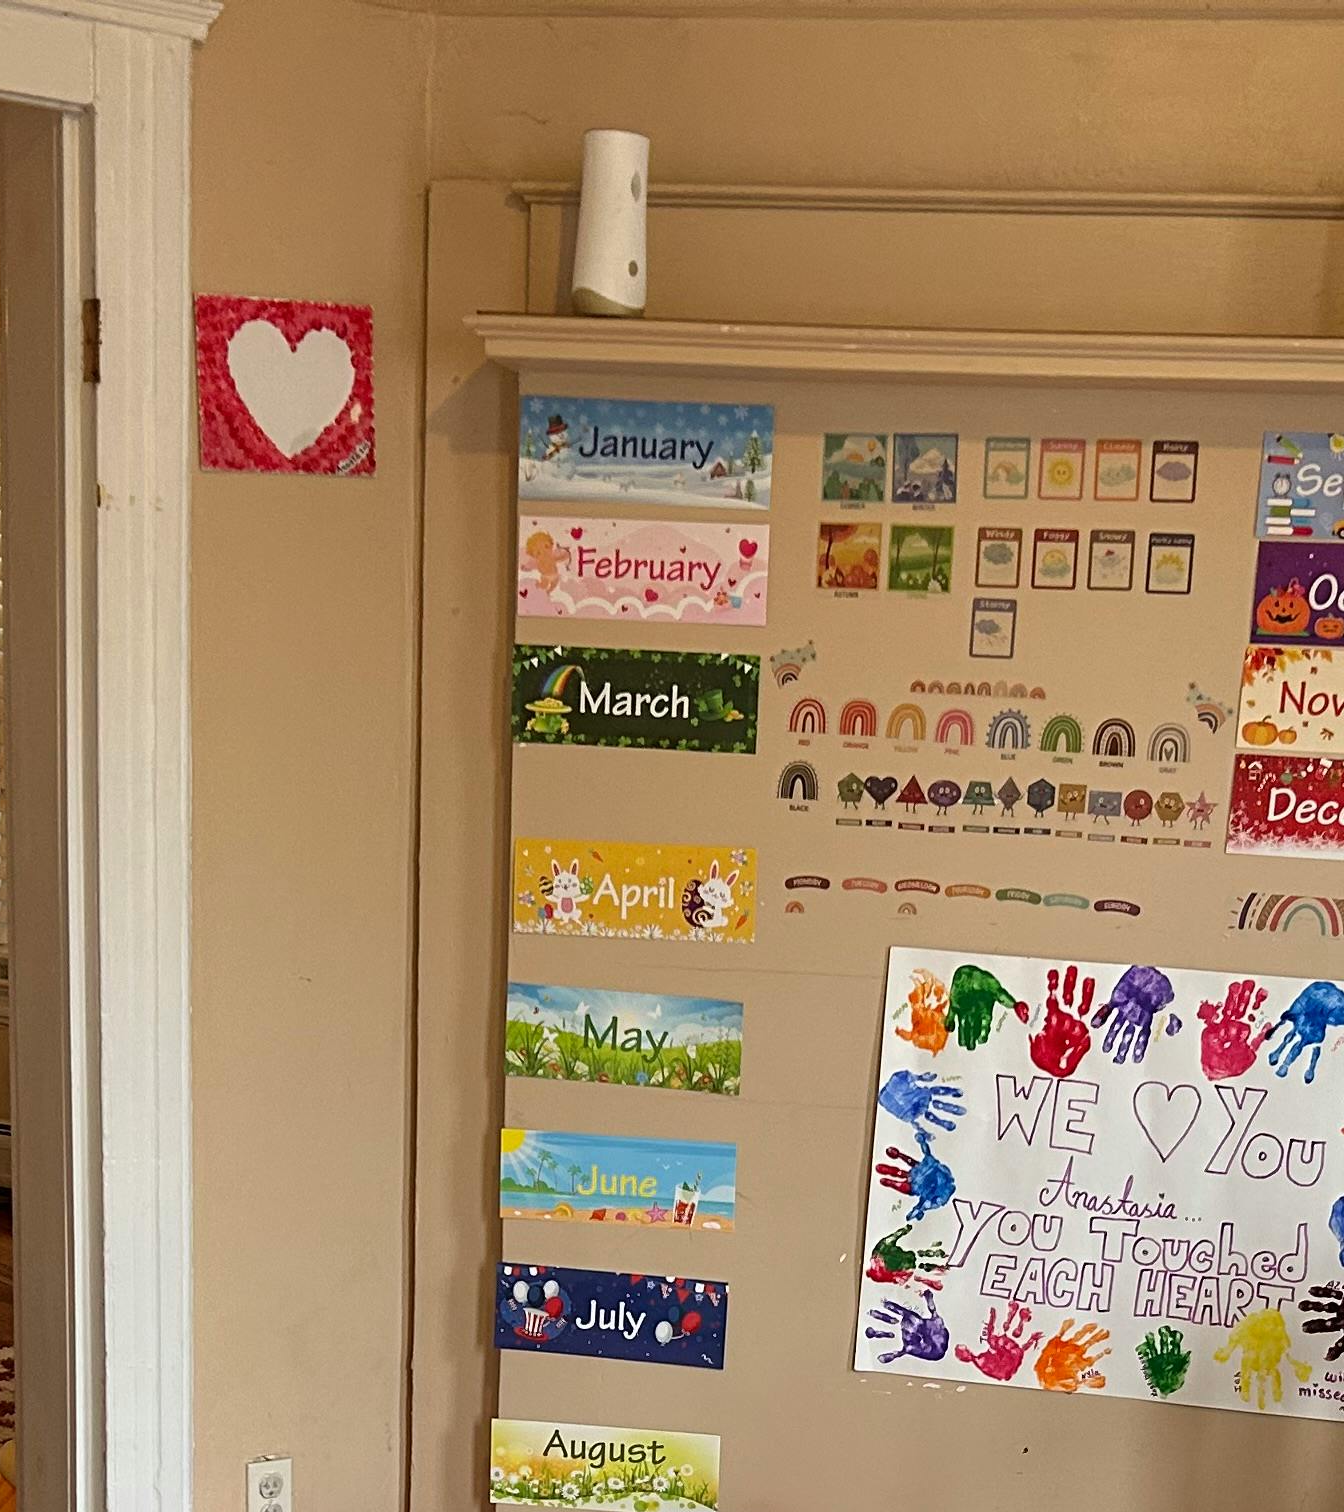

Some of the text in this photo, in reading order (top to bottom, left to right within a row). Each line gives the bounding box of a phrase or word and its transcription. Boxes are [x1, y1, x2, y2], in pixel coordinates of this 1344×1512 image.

[577, 426, 715, 468] January
[576, 547, 721, 590] February
[578, 681, 691, 721] March
[592, 873, 676, 919] April
[583, 1012, 669, 1064] May
[995, 1074, 1099, 1155] WE
[578, 1164, 657, 1198] June
[1090, 1217, 1309, 1284] Touched
[980, 1254, 1295, 1329] EACH HEART
[575, 1298, 646, 1341] July
[542, 1429, 667, 1468] August
